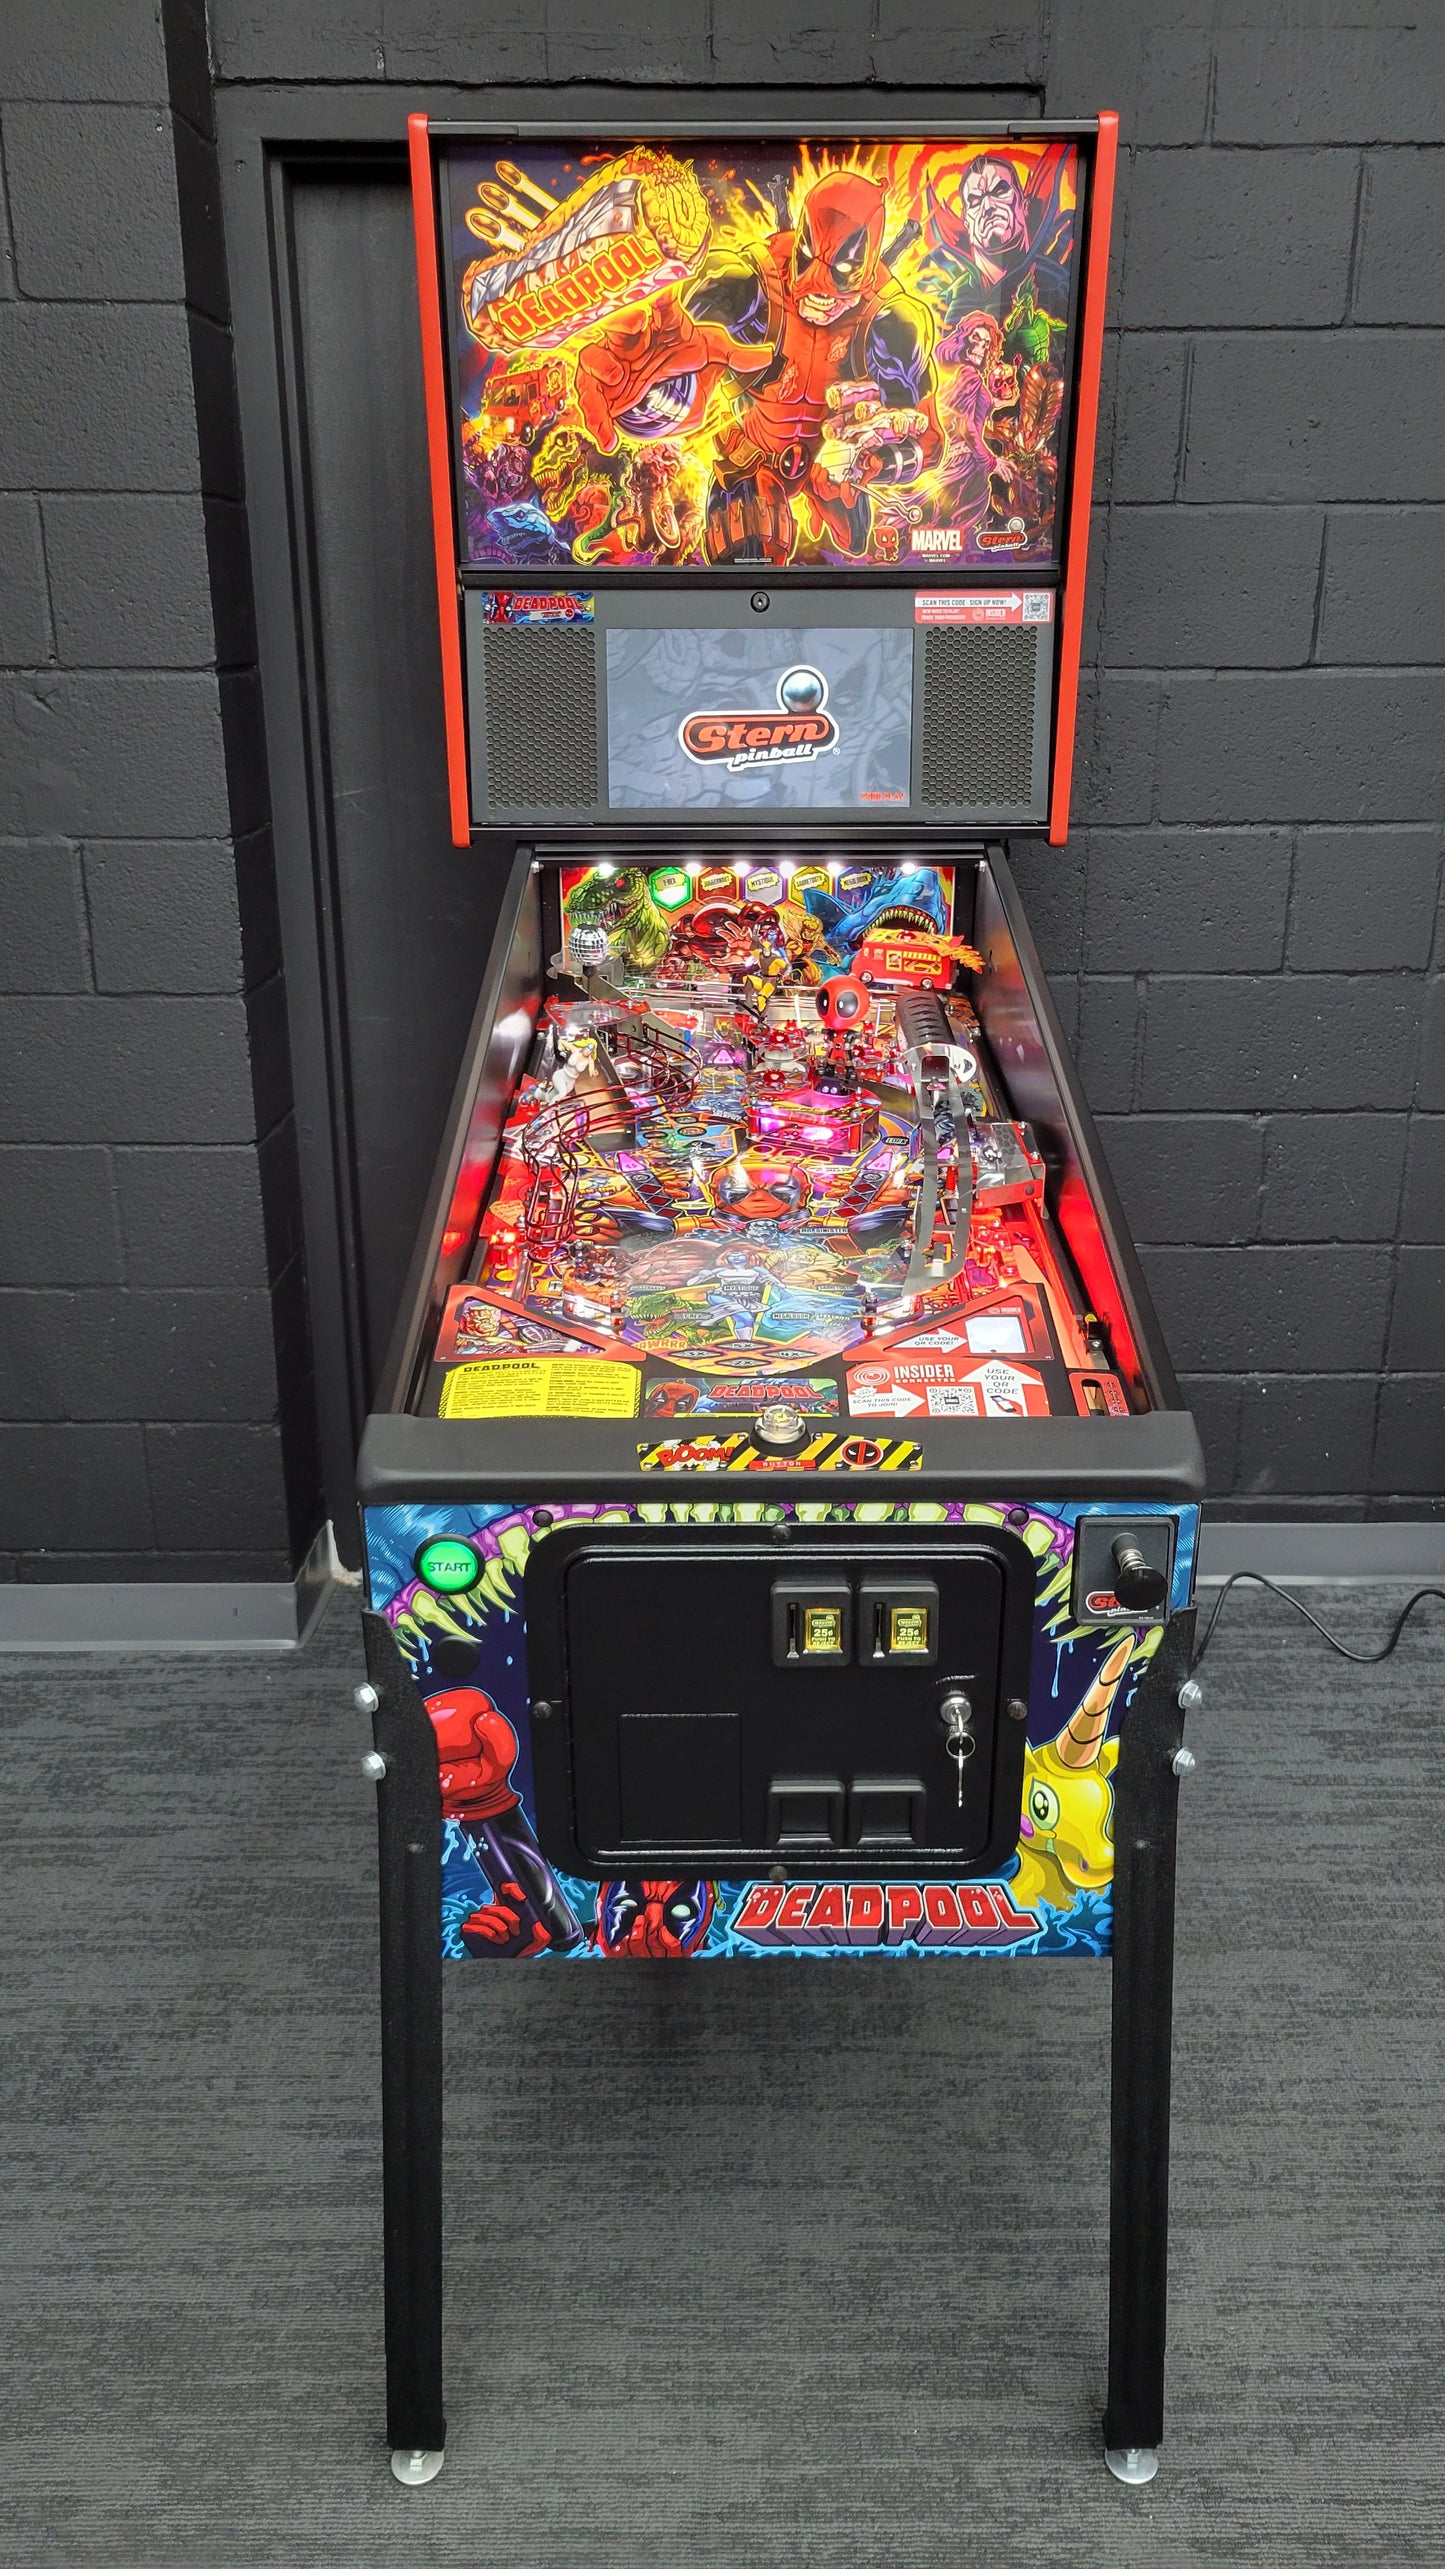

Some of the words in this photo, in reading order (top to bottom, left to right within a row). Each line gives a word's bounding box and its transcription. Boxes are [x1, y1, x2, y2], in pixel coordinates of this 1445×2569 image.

[498, 234, 663, 340] DEADPOOL
[912, 530, 963, 551] MARVEL
[513, 596, 585, 610] DEADPOOL
[697, 722, 819, 752] Stern
[733, 743, 813, 765] pinball
[750, 875, 774, 888] MYSTIQUE
[463, 1362, 540, 1373] DEADPOOL
[893, 1364, 955, 1379] INSIDER
[986, 1367, 1010, 1375] USE
[707, 1384, 827, 1400] DEADPOOL
[656, 1443, 735, 1467] BOOM!
[426, 1561, 471, 1573] START
[813, 1628, 834, 1637] 25¢
[899, 1628, 920, 1637] 25¢
[732, 1884, 1041, 1931] DEADPOOL
